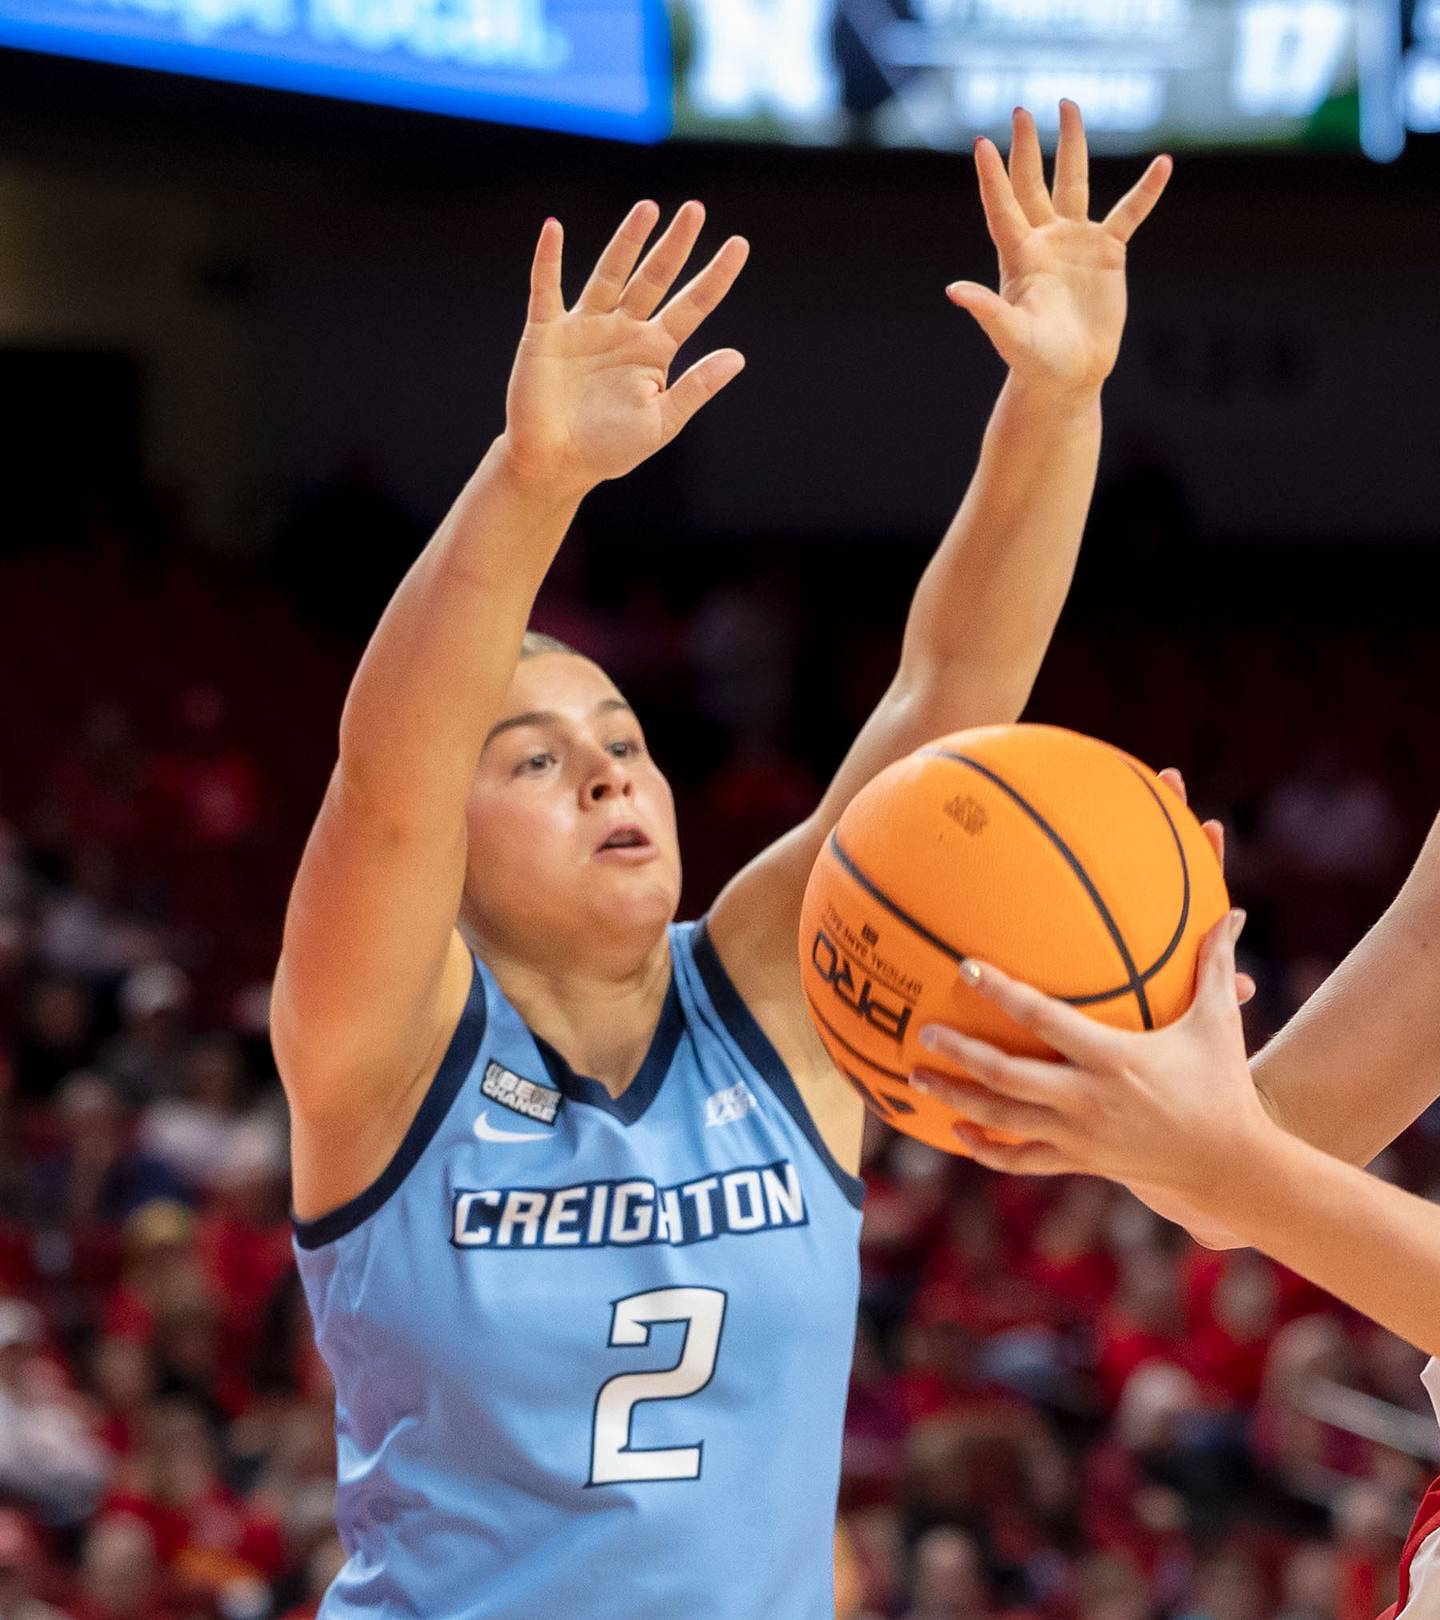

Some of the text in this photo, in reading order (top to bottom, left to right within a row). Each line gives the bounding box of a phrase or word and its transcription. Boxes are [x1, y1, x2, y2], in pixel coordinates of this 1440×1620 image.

[810, 930, 912, 1046] PRO
[453, 1161, 806, 1247] CREIGHTON
[584, 1286, 727, 1487] 2
